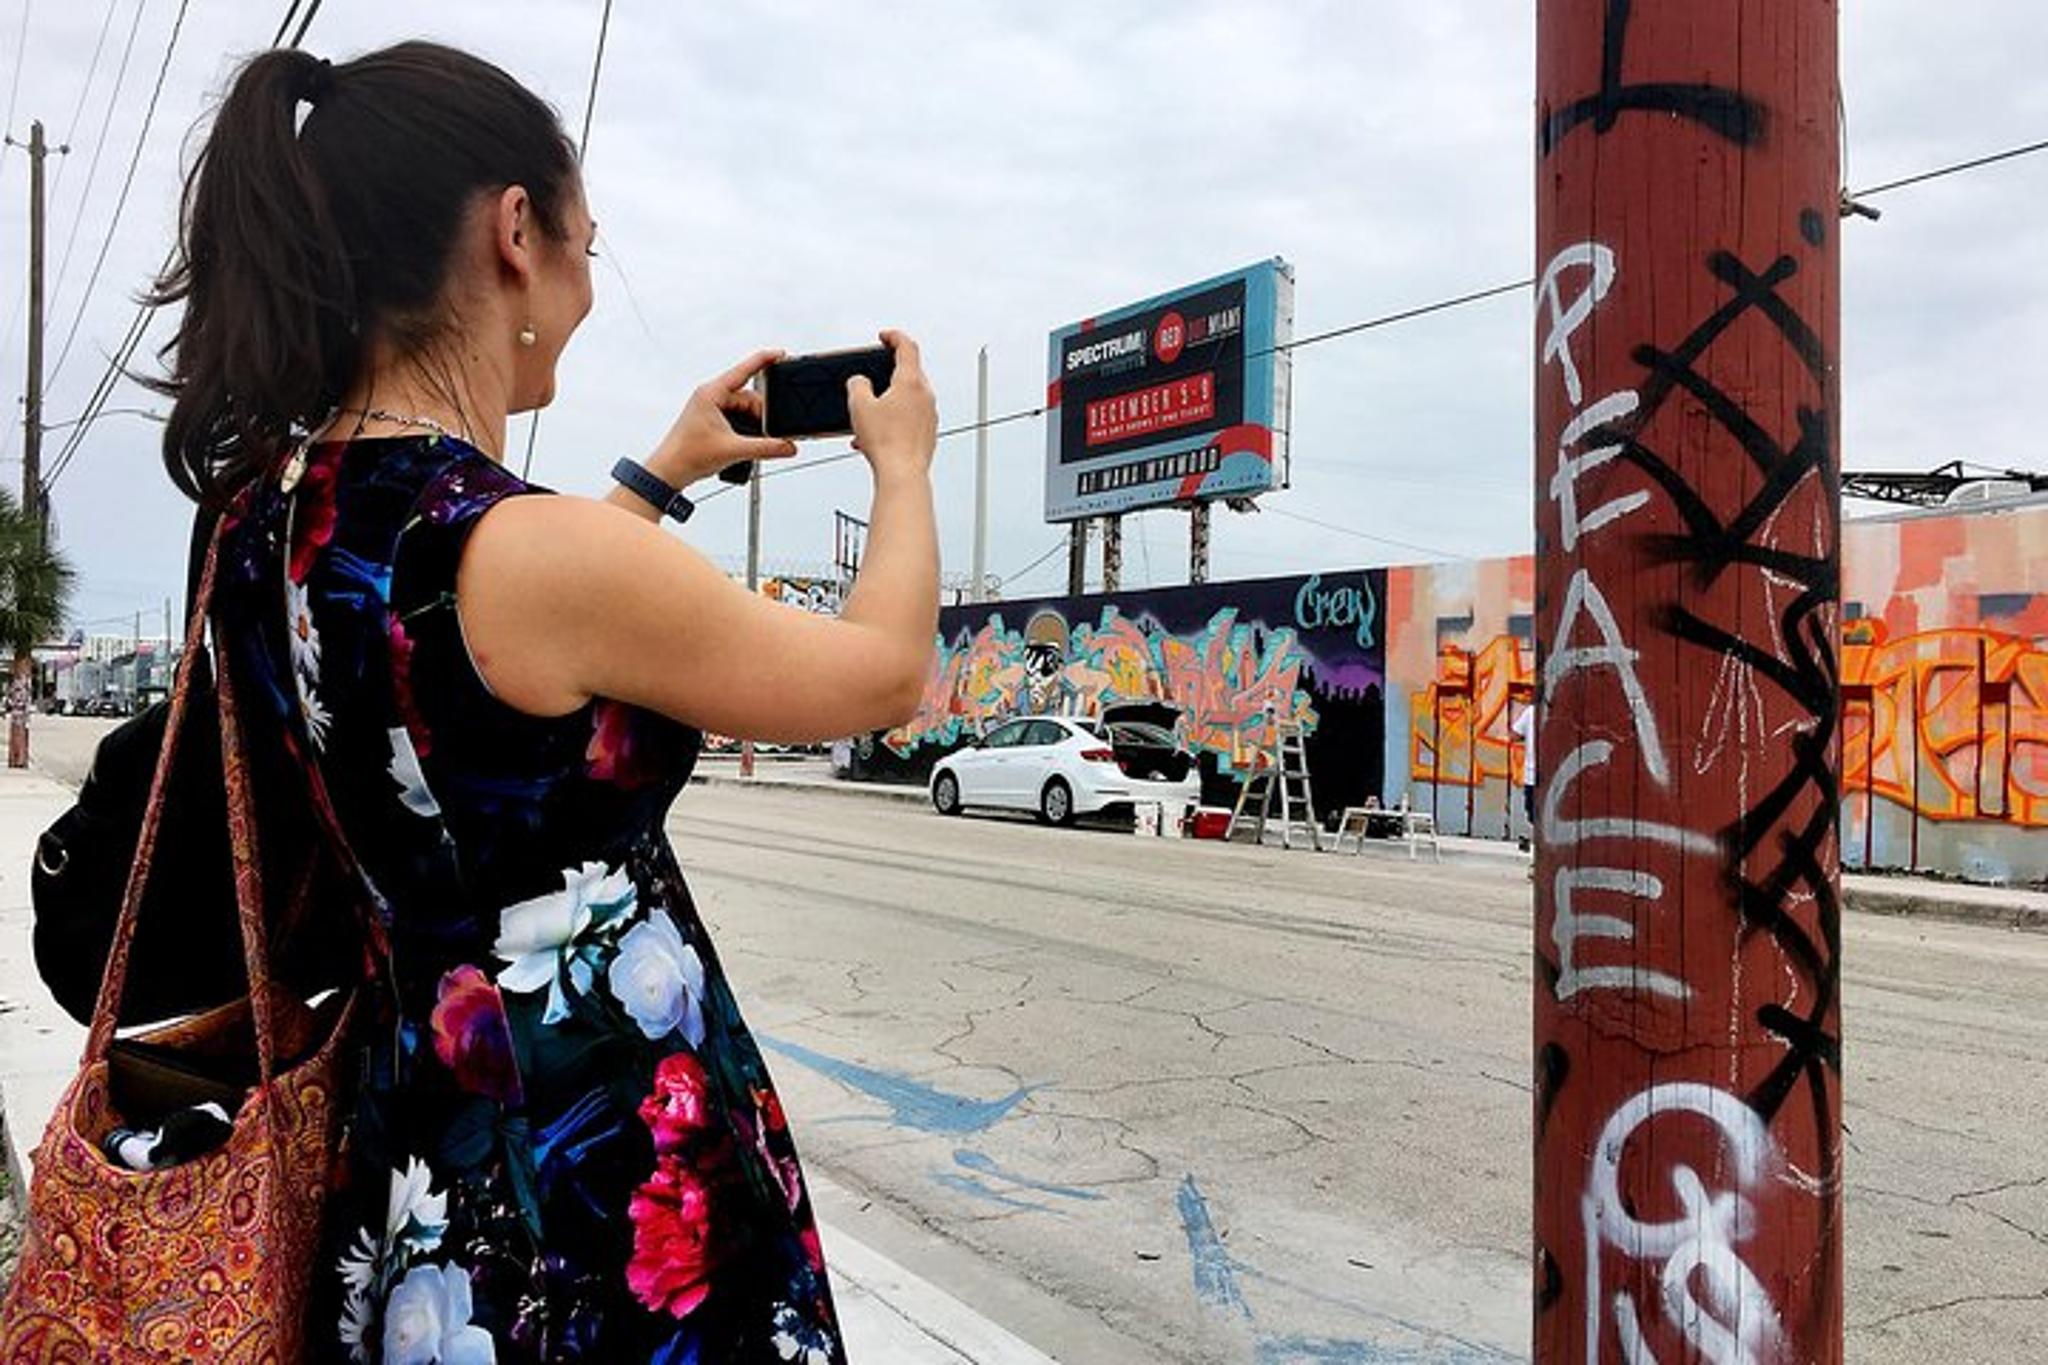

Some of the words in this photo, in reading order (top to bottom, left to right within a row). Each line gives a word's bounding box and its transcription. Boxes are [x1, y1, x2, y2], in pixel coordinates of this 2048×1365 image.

[1159, 325, 1182, 349] RED
[1091, 388, 1170, 428] DECEMBER
[1295, 572, 1376, 649] Crew
[1537, 243, 1720, 1001] PEACE
